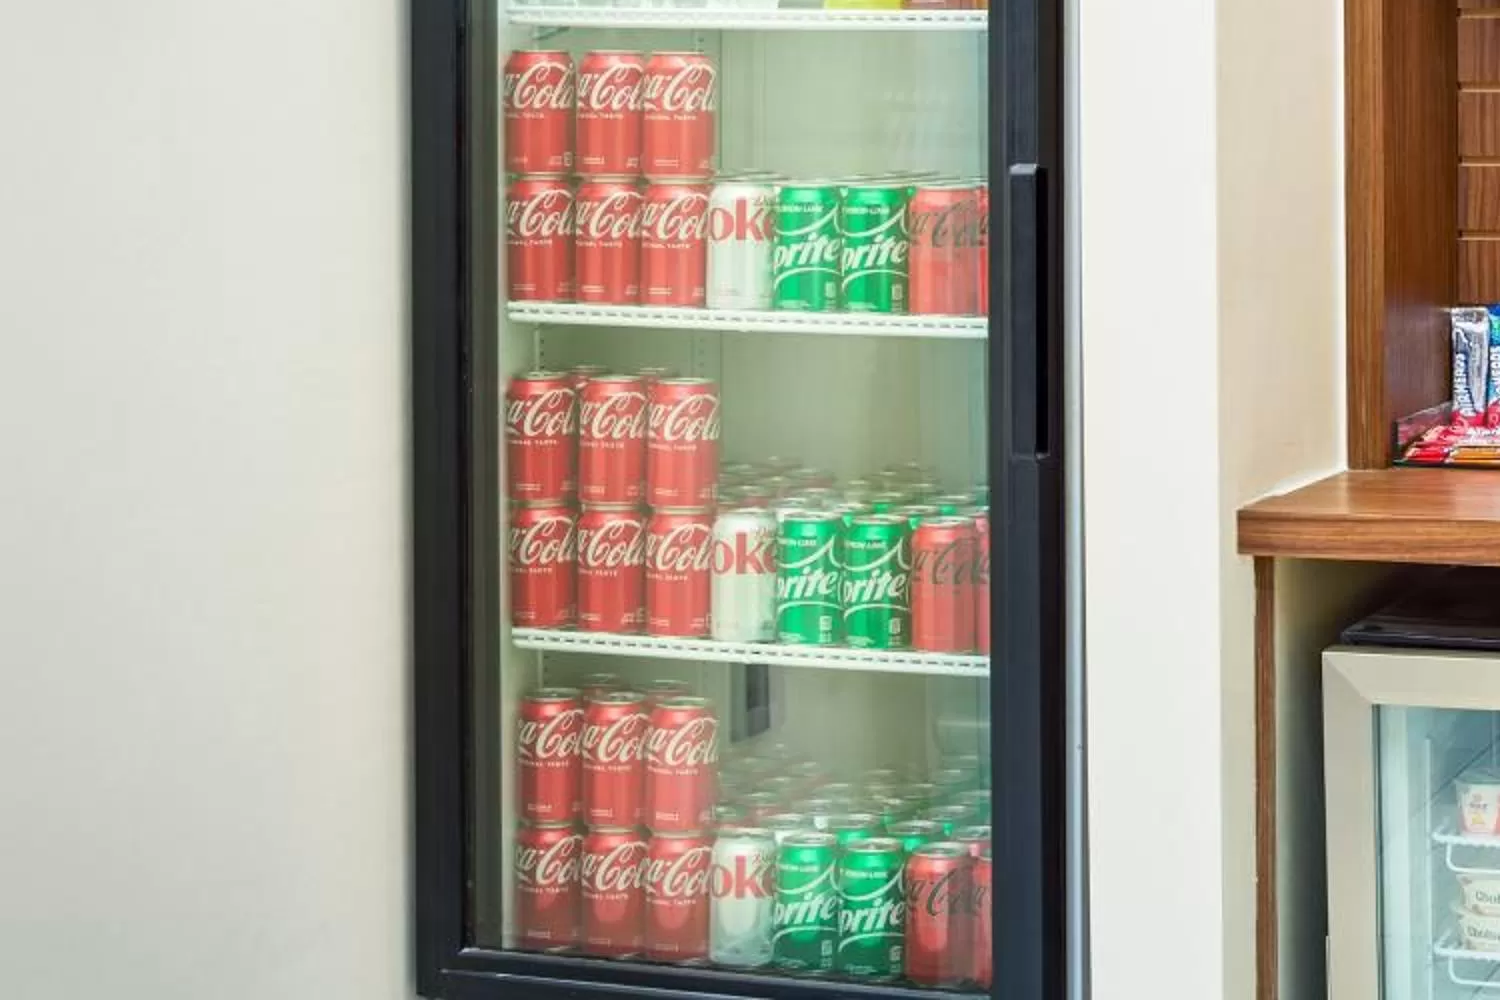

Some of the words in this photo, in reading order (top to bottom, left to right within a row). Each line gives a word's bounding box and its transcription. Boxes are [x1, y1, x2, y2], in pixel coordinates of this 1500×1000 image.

[774, 231, 840, 275] prite
[841, 234, 908, 277] prite
[777, 565, 838, 599] prite
[843, 568, 907, 604] prite
[774, 891, 837, 926] prite
[839, 898, 904, 936] prite
